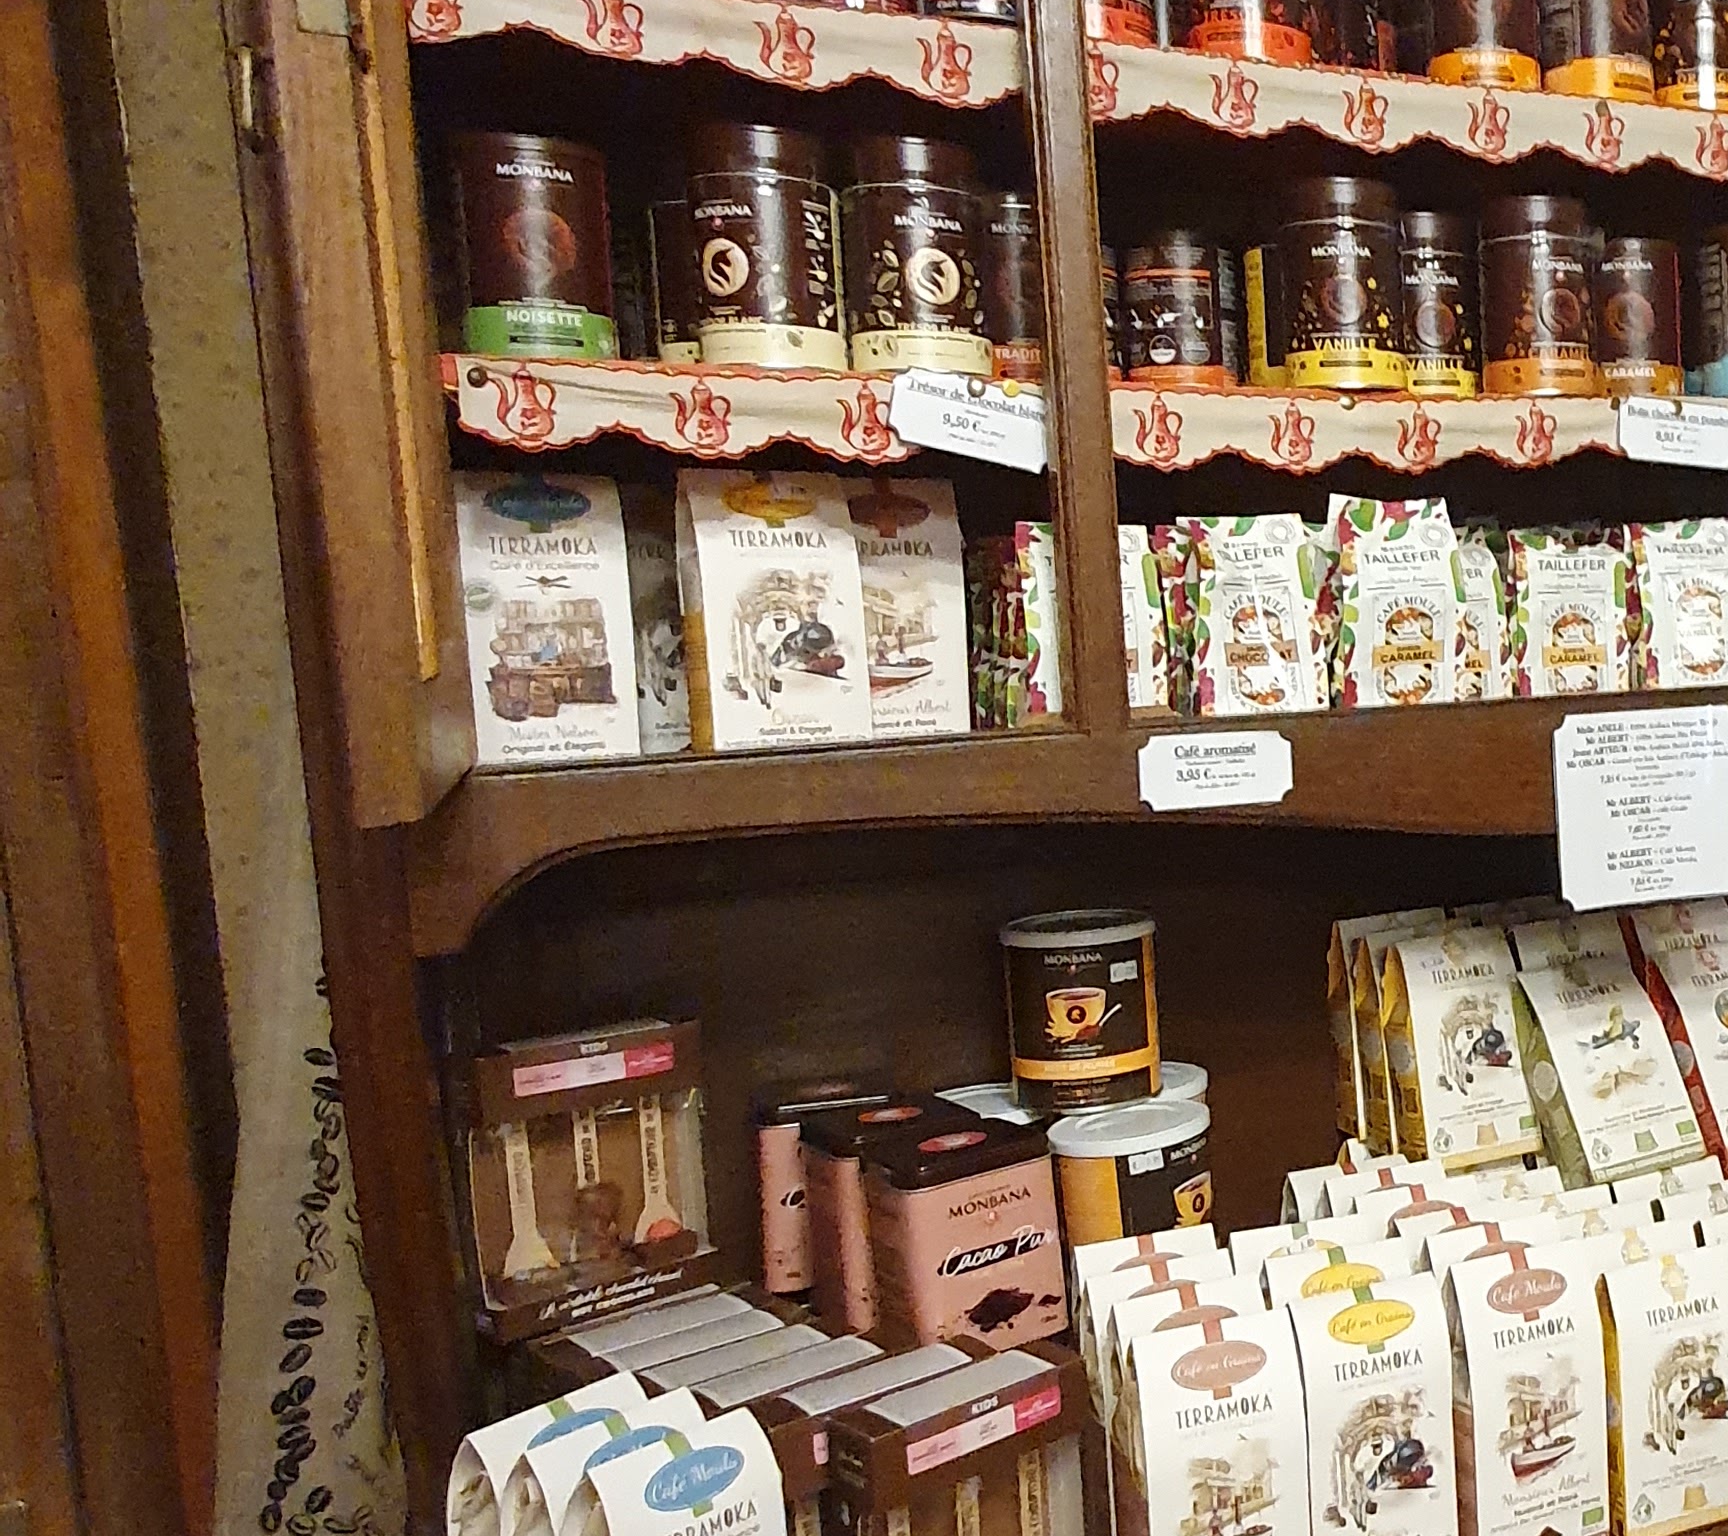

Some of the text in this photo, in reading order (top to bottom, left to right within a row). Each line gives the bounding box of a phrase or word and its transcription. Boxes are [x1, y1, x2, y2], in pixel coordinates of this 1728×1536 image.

[496, 162, 575, 184] MONBANA
[893, 214, 963, 234] MONBANA
[1311, 244, 1372, 259] MONBANA
[506, 309, 584, 328] NOISETTE
[1312, 338, 1378, 352] VANILLE
[1406, 360, 1464, 372] VANILLE
[1604, 366, 1657, 379] CARAMEL
[907, 376, 946, 397] Trésor
[950, 387, 965, 401] de
[942, 412, 970, 431] 9,50
[488, 535, 598, 557] TERRAMOKA
[728, 529, 828, 549] TERRAMOKA
[1364, 548, 1441, 565] TAILLEFER
[1537, 559, 1606, 571] TAILLEFER
[1380, 650, 1437, 664] CARAMEL
[1549, 654, 1601, 664] CARAMEL
[1174, 745, 1200, 758] Café
[1044, 950, 1103, 965] MONBANA
[1431, 963, 1495, 985] TERRAMOKA
[948, 1185, 1032, 1220] MONBANA
[942, 1223, 1055, 1278] Cacao Pur
[1491, 1273, 1564, 1305] Café Moulu
[1645, 1295, 1720, 1328] TERRAMOKA
[1332, 1317, 1358, 1336] Café
[1492, 1316, 1575, 1350] TERRAMOKA
[1334, 1349, 1424, 1383] TERRAMOKA
[970, 1395, 999, 1415] KIDS
[1174, 1393, 1273, 1430] TERRAMOKA
[652, 1452, 739, 1503] Café Moulu
